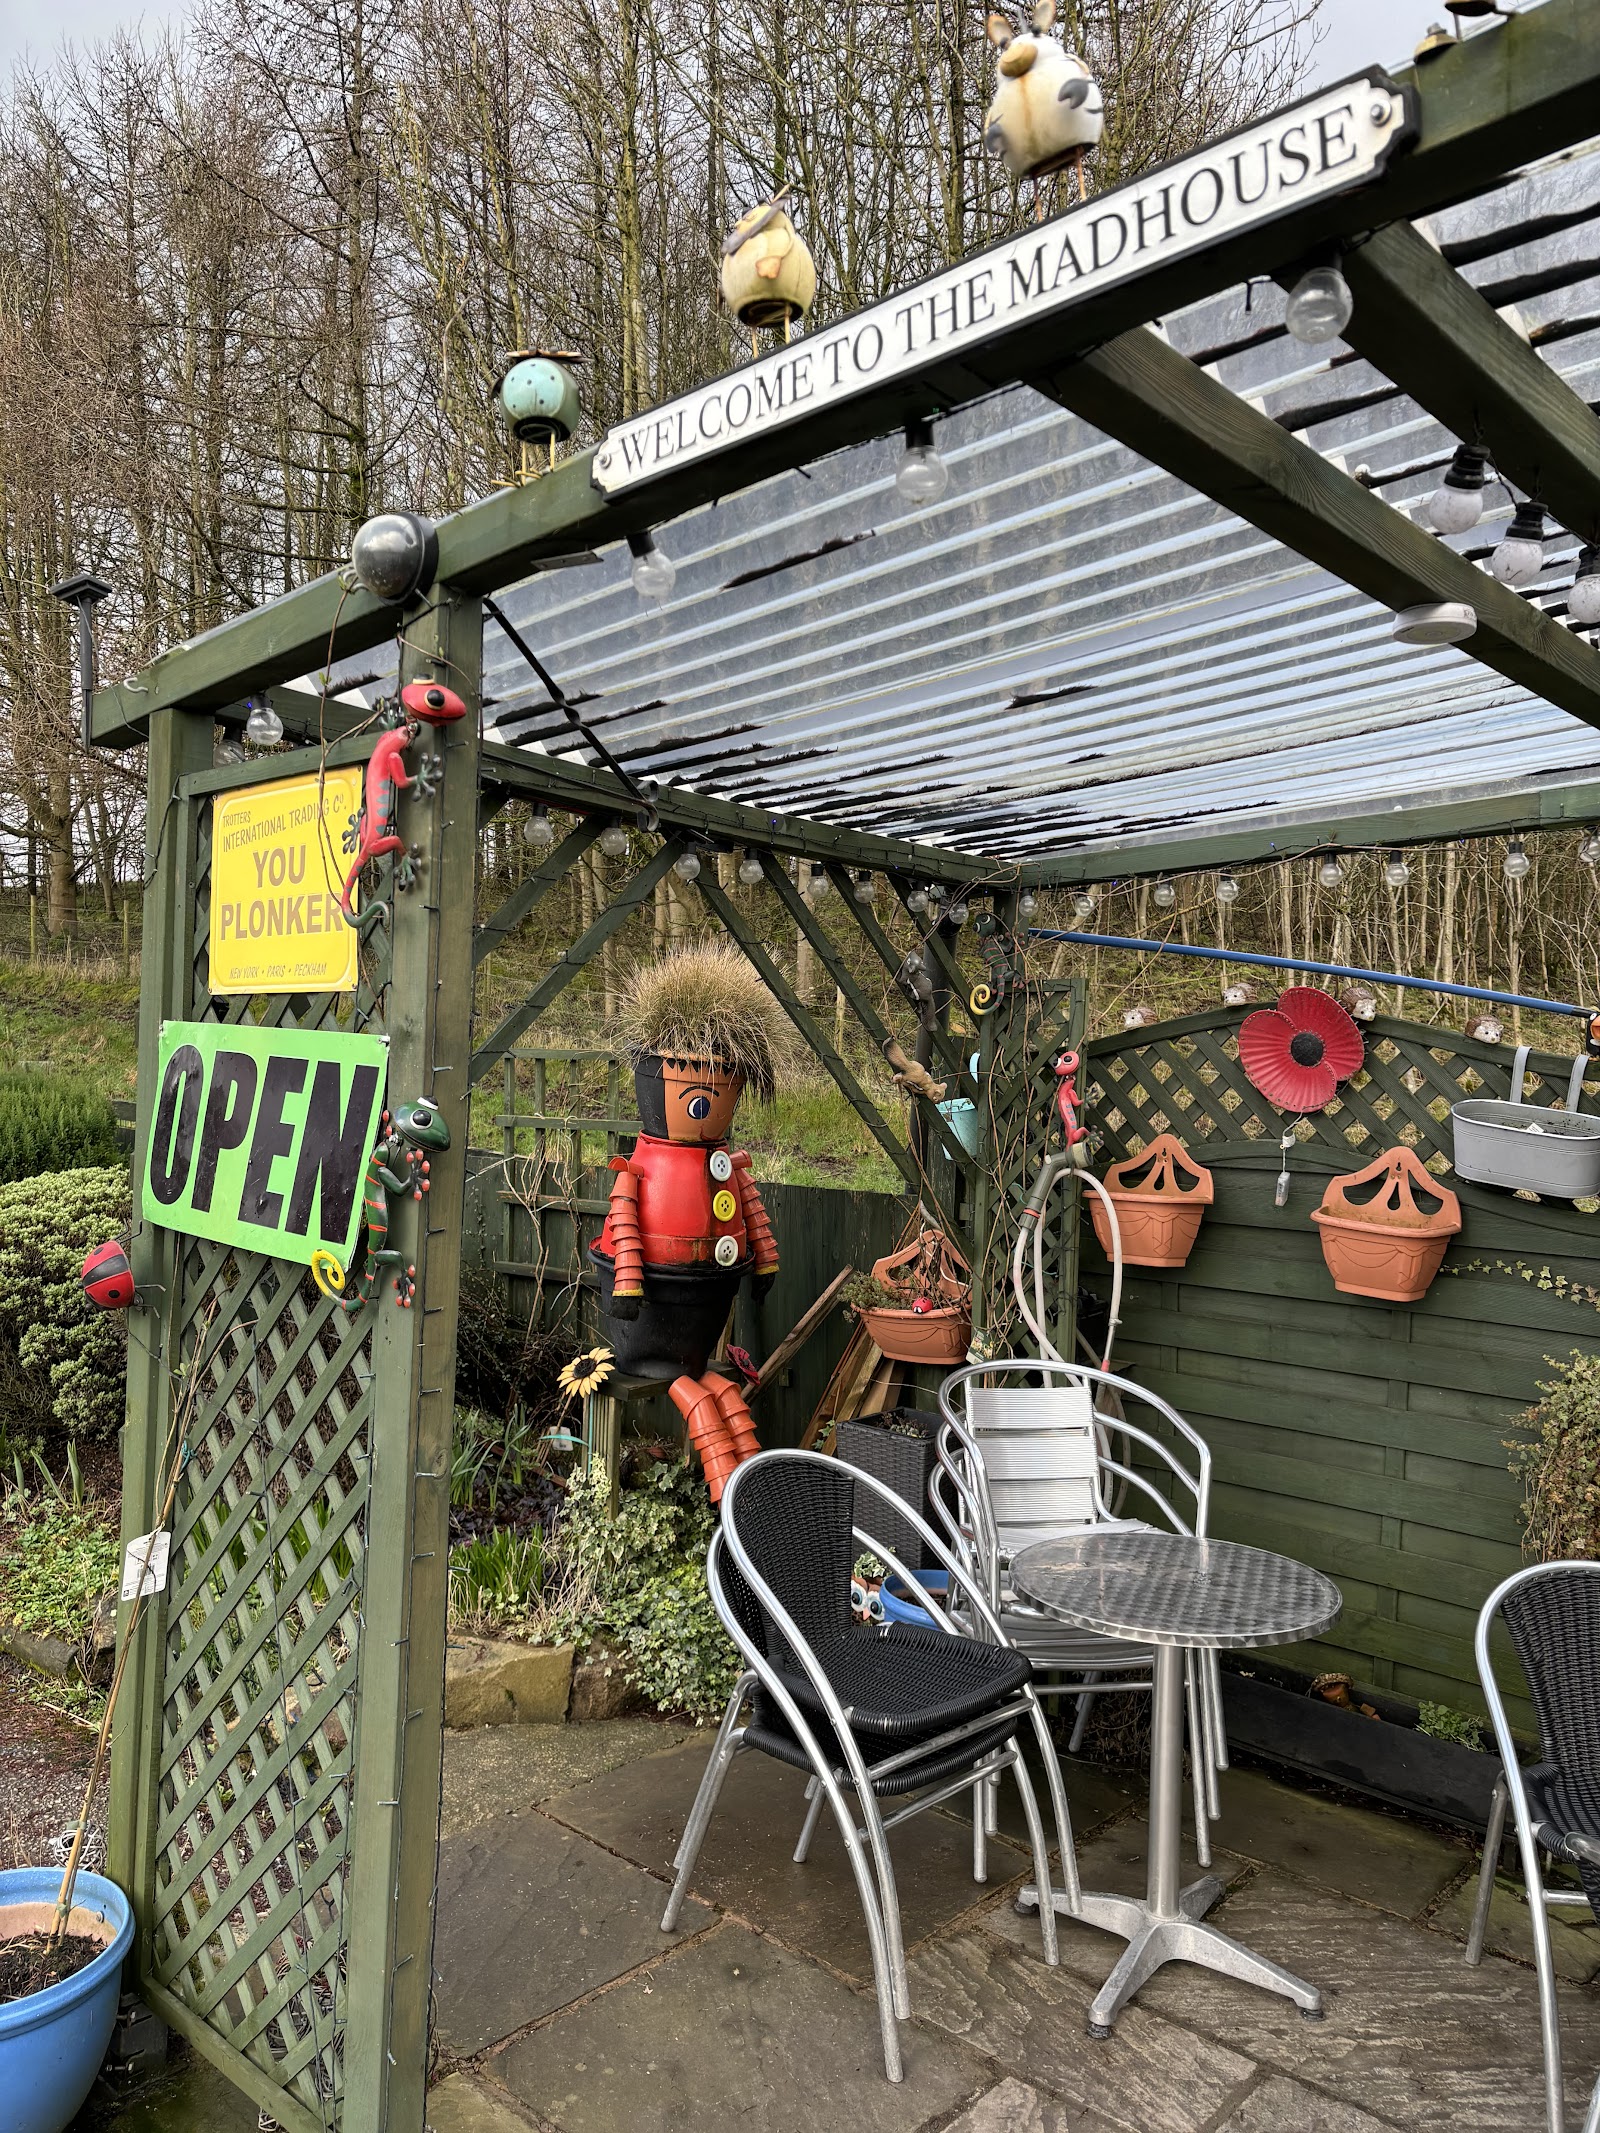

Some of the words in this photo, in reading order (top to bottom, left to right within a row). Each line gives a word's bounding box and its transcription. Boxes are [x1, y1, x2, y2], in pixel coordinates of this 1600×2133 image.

[619, 353, 814, 474] WELCOME
[823, 324, 883, 387] TO
[895, 269, 996, 355] THE
[1007, 104, 1358, 308] MADHOUSE
[222, 810, 251, 828] TROTTERS
[223, 819, 286, 853] INTERNATIONAL
[289, 799, 330, 829] TRADING
[253, 844, 306, 888] YOU
[221, 893, 344, 941] PLONKER
[229, 967, 243, 980] NEW
[243, 965, 260, 978] YORK
[266, 964, 286, 978] PARIS
[294, 963, 327, 977] PECKHAM
[150, 1044, 380, 1245] OPEN
